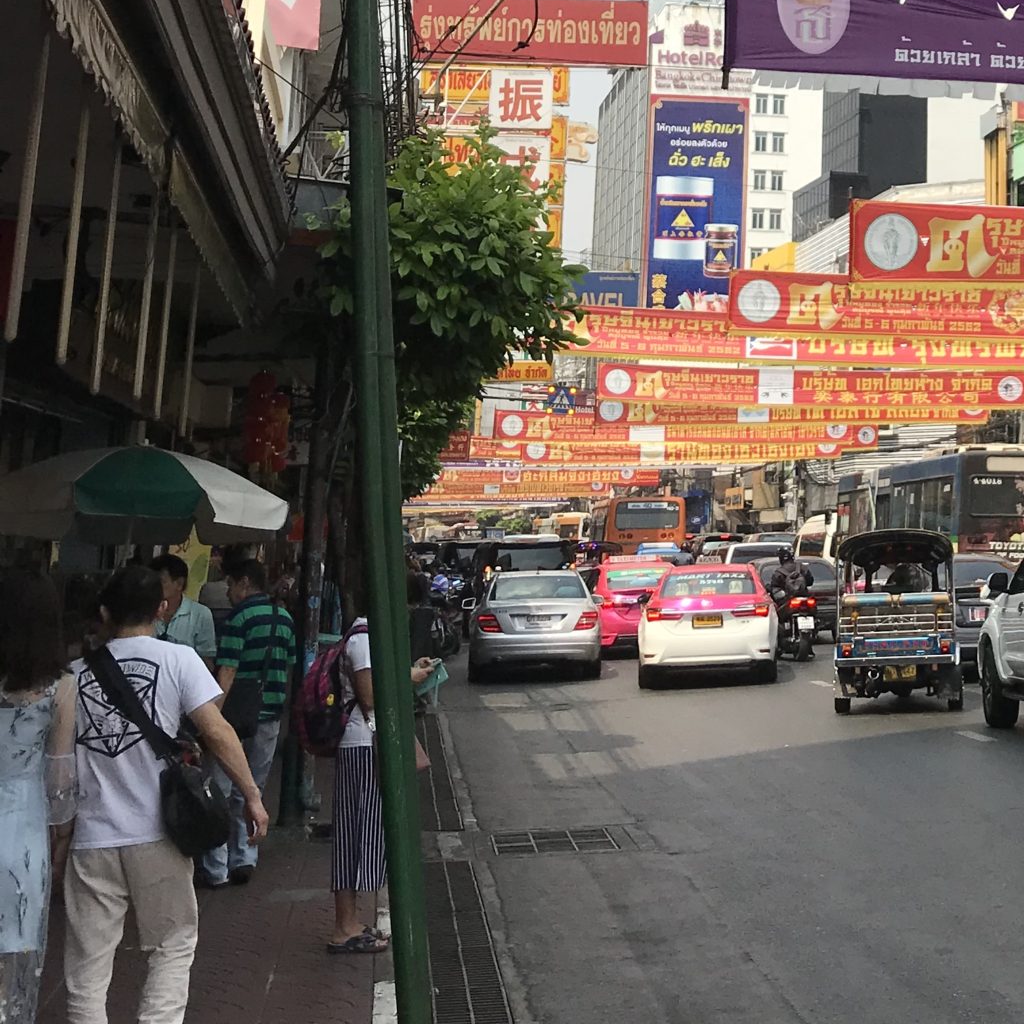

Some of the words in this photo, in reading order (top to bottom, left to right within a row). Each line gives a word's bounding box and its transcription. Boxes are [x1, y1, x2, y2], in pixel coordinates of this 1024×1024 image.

[658, 49, 702, 66] Hotel
[691, 119, 744, 136] พริกเผา
